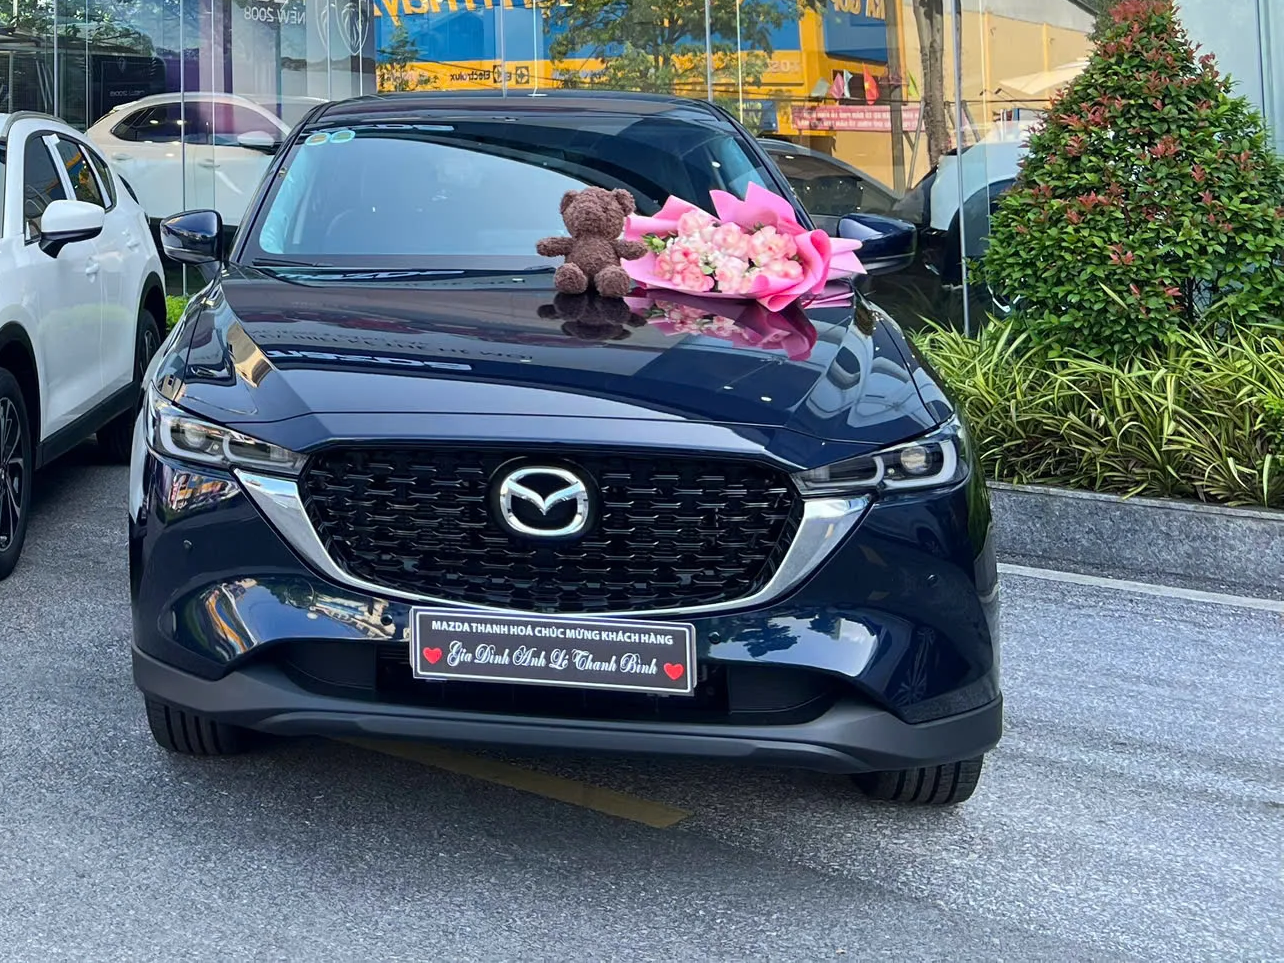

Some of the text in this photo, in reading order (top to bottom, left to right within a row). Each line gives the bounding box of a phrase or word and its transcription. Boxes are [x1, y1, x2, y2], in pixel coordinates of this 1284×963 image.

[431, 620, 674, 646] MAZDA THANH HOÁ CHÚC MỪNG KHÁCH HÀNG
[447, 640, 473, 667] Gia
[512, 645, 547, 667] Anh
[571, 648, 617, 673] Thanh
